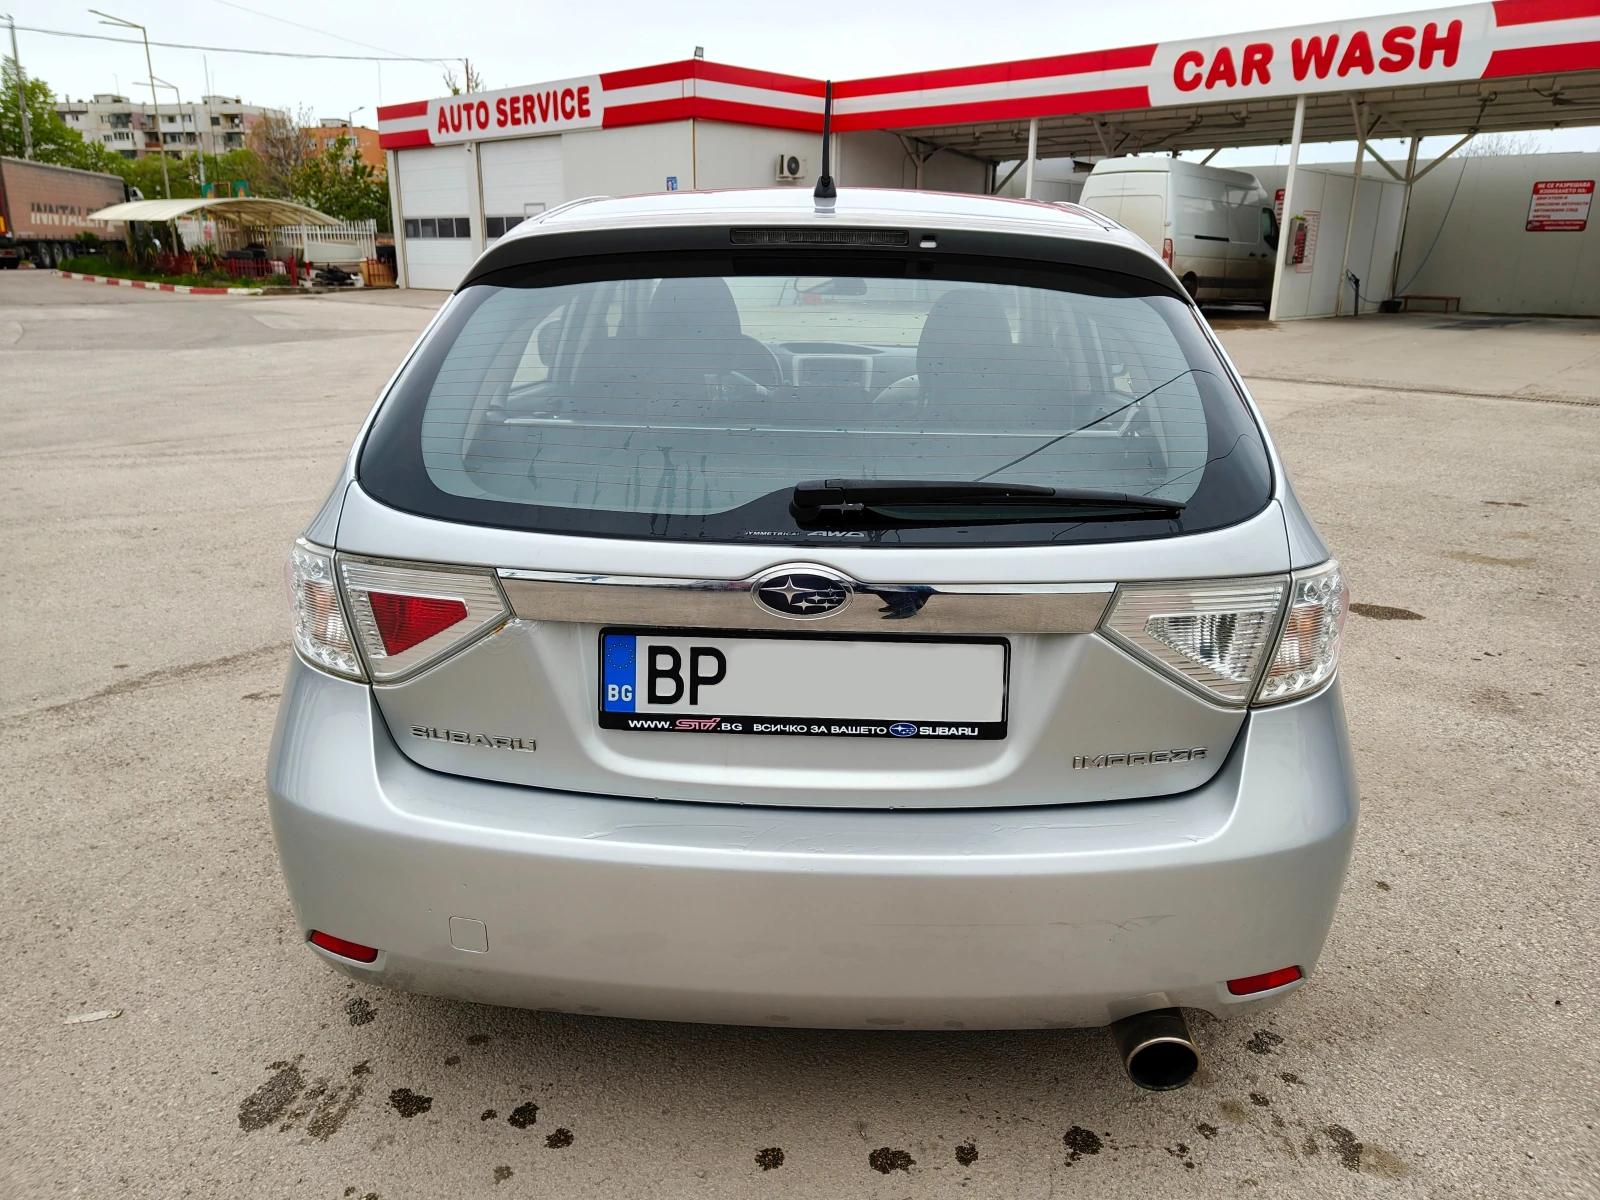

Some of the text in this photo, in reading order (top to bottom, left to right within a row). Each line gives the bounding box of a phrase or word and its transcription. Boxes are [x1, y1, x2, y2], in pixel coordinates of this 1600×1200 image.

[1173, 19, 1463, 92] CAR WASH
[437, 85, 592, 135] AUTO SERVICE
[607, 645, 727, 706] BG BP
[409, 724, 537, 753] SUBARU
[753, 723, 807, 733] ВСИЧКО
[831, 725, 887, 735] ВАШЕТО
[919, 727, 979, 736] SUBARU
[1073, 746, 1208, 770] IMPREZA
